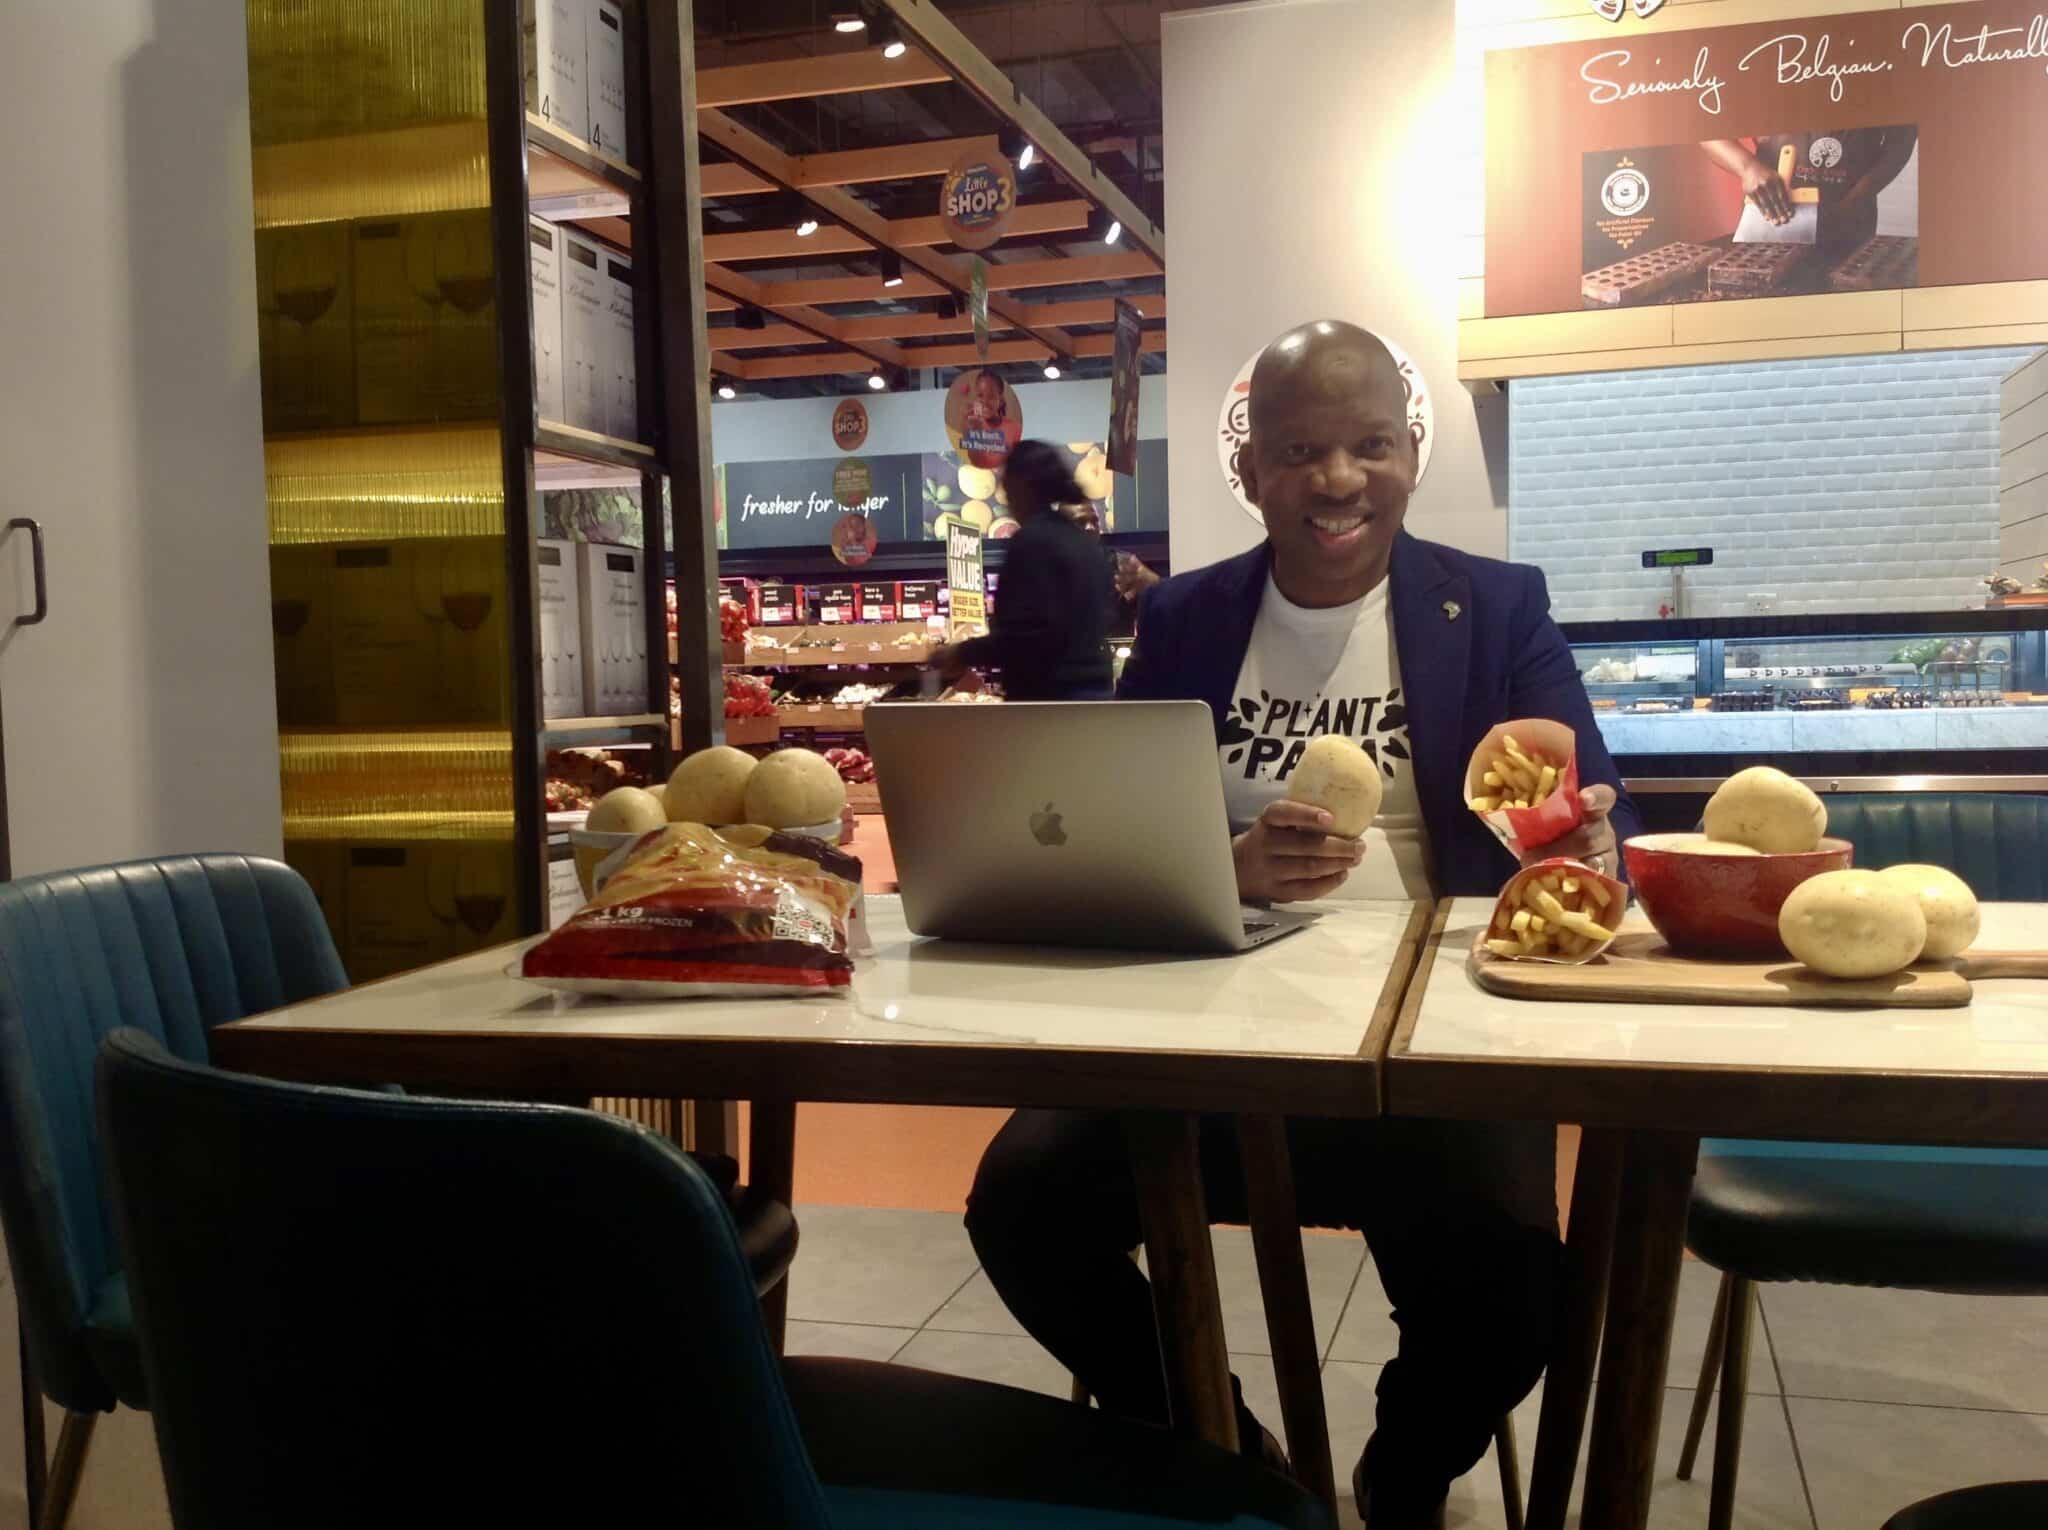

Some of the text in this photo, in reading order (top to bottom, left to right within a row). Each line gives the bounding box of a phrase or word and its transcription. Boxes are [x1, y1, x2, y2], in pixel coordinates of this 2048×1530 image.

[1580, 46, 1725, 114] Seriously
[1738, 34, 1893, 101] Belgian.
[542, 95, 550, 122] 4
[593, 124, 601, 150] 4
[947, 188, 998, 216] SHOP
[741, 491, 889, 522] fresher for ger
[950, 524, 980, 559] Hyper
[950, 558, 981, 593] VALUE
[1262, 696, 1382, 737] PLANT
